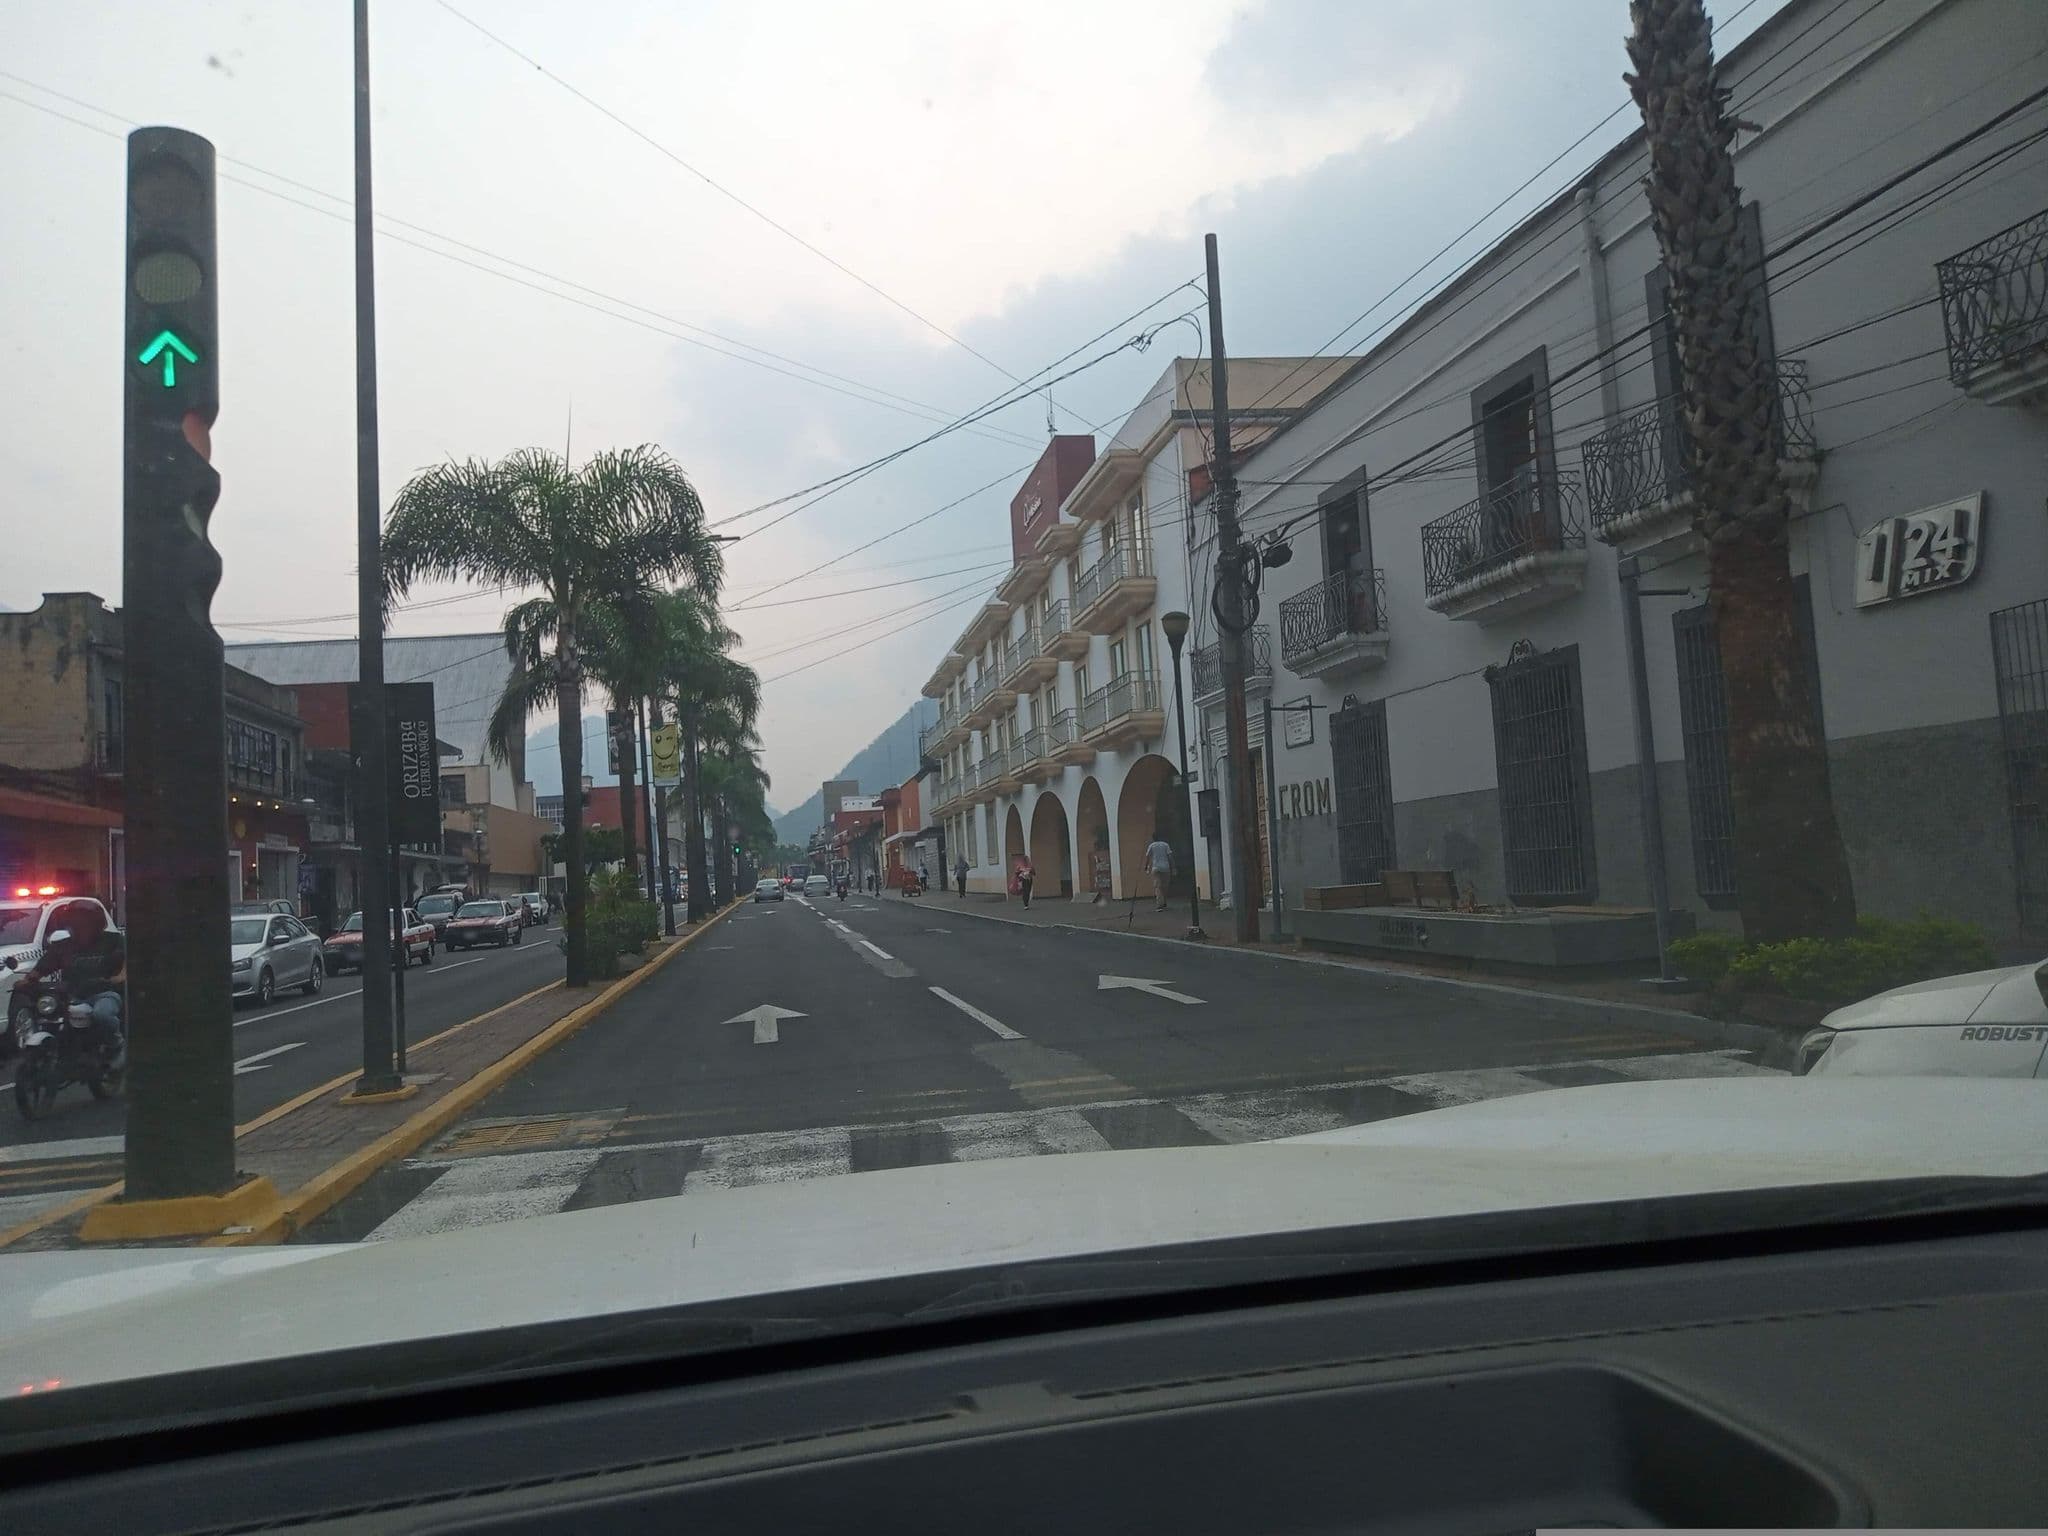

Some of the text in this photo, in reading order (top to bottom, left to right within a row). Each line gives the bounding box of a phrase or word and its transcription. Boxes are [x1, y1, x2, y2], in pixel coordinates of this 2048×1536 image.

[1901, 562, 1960, 590] MIX
[1279, 777, 1332, 820] CROM
[1960, 1027, 2048, 1041] ROBUST
